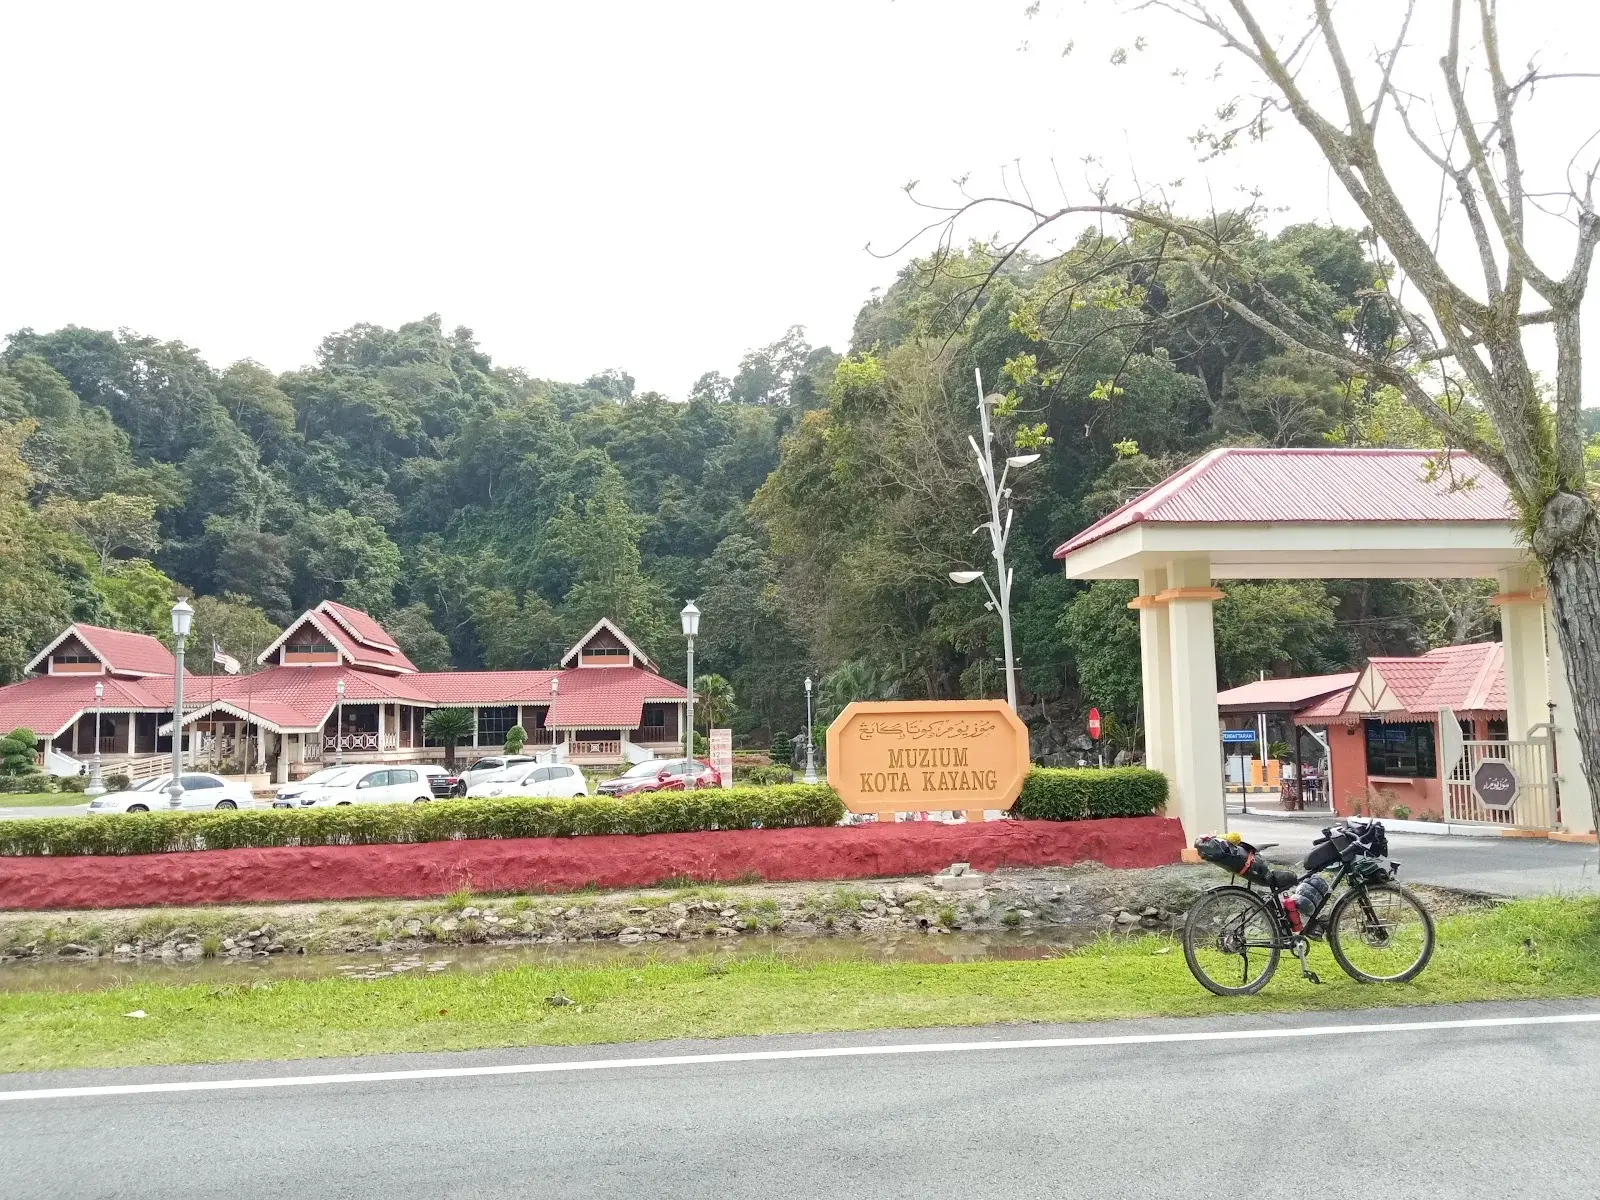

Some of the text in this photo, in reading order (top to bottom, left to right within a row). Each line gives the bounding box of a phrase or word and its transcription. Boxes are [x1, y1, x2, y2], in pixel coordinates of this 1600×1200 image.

[888, 747, 969, 769] MUZIUM
[860, 770, 998, 793] KOTA KAYANG
